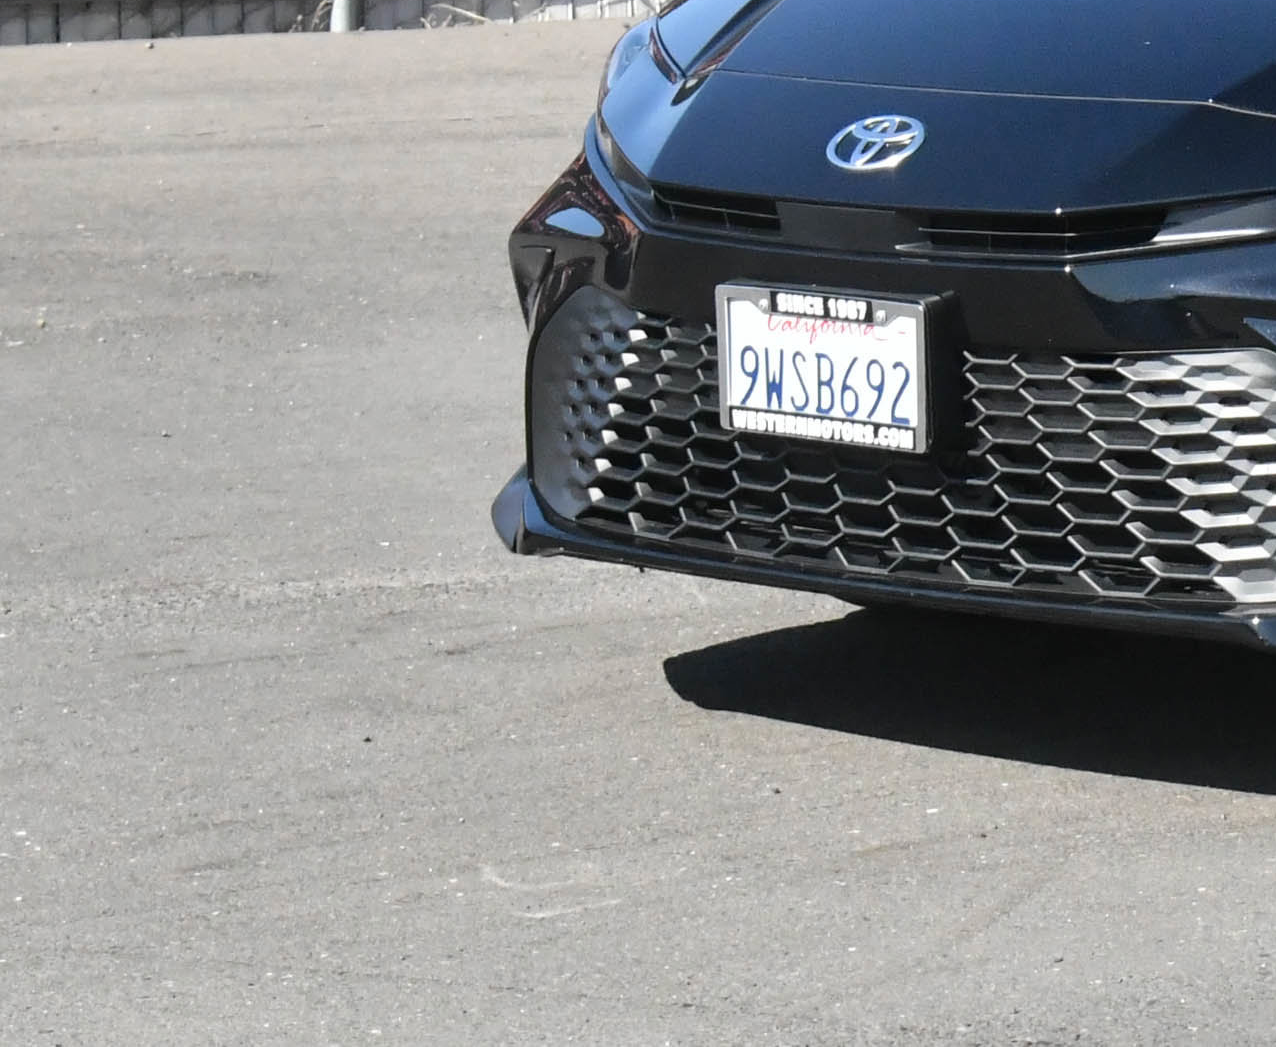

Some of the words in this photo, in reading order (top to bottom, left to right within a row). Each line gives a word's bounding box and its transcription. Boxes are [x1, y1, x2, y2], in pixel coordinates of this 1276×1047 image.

[776, 292, 825, 317] SINCE
[740, 344, 911, 426] 9WSB692
[731, 408, 915, 450] WESTERNMOTORS.COM
